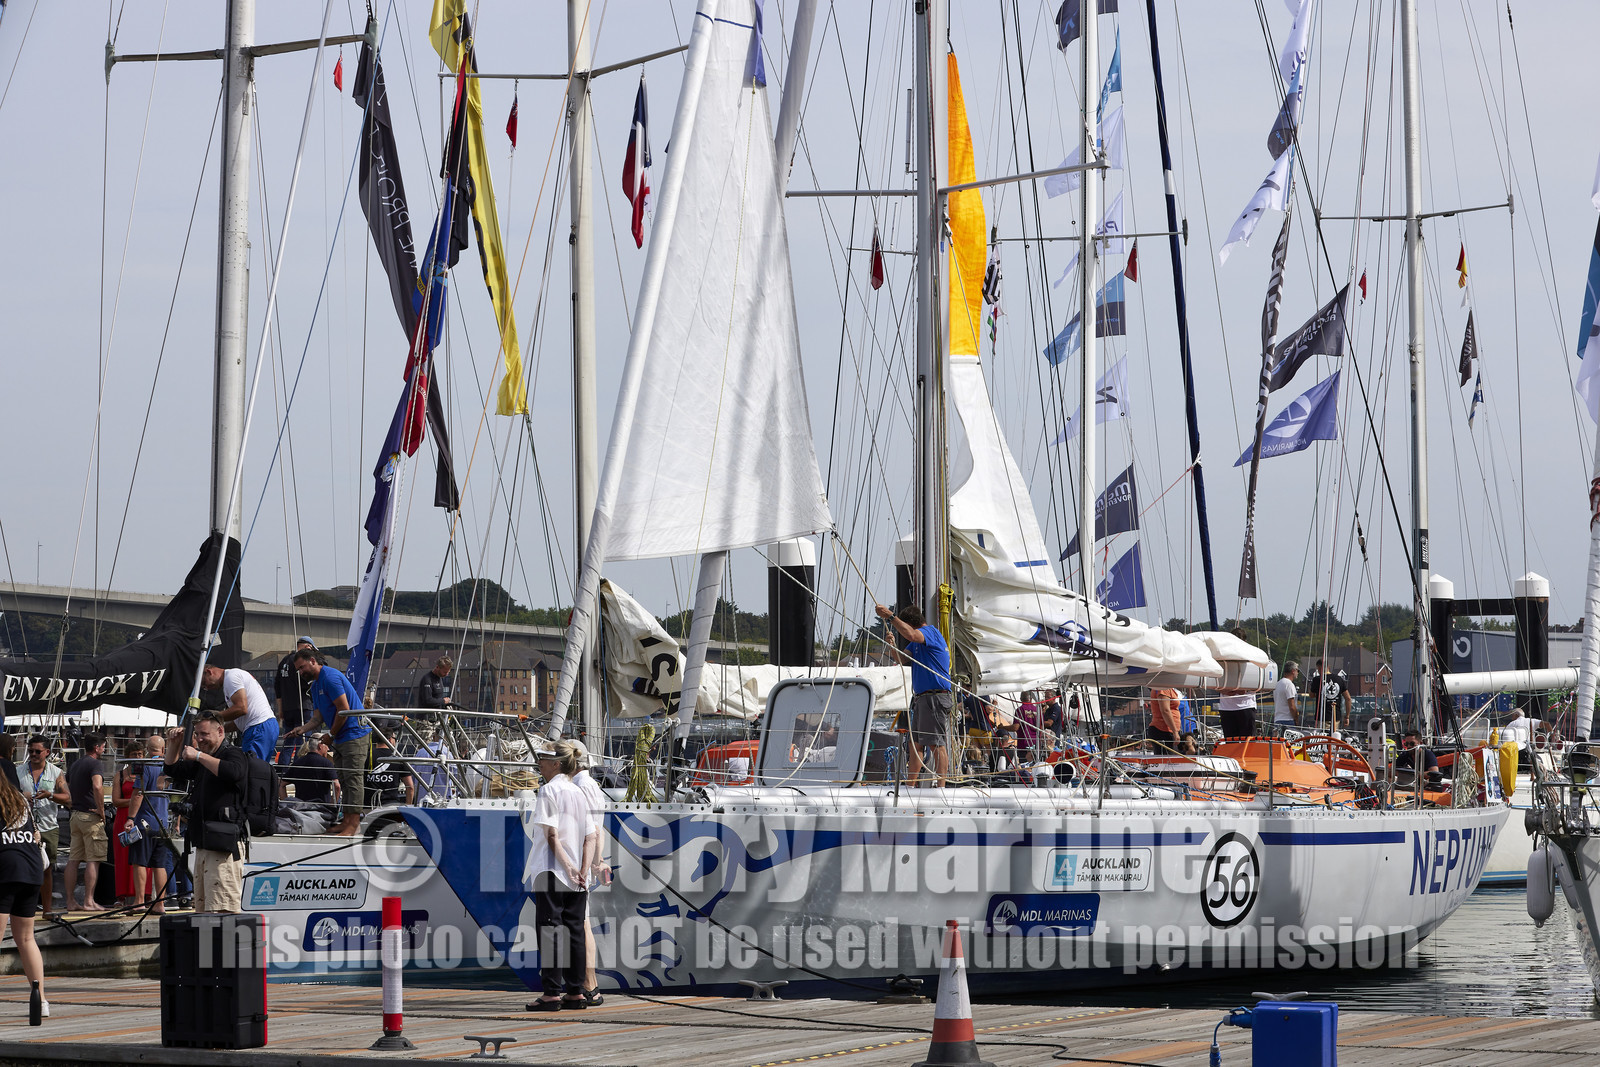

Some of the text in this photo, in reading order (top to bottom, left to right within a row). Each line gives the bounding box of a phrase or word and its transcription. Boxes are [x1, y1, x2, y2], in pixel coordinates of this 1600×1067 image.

[140, 668, 167, 694] VI
[1, 830, 36, 845] MSO
[1081, 857, 1142, 870] AUCKLAND
[1104, 873, 1143, 882] MAKAURAU
[1208, 854, 1250, 909] 56
[285, 878, 357, 891] AUCKLAND
[278, 892, 359, 902] TĀMAKI MAKAURAU
[1019, 908, 1093, 922] MDL MARINAS
[341, 924, 421, 937] MDL MANAS
